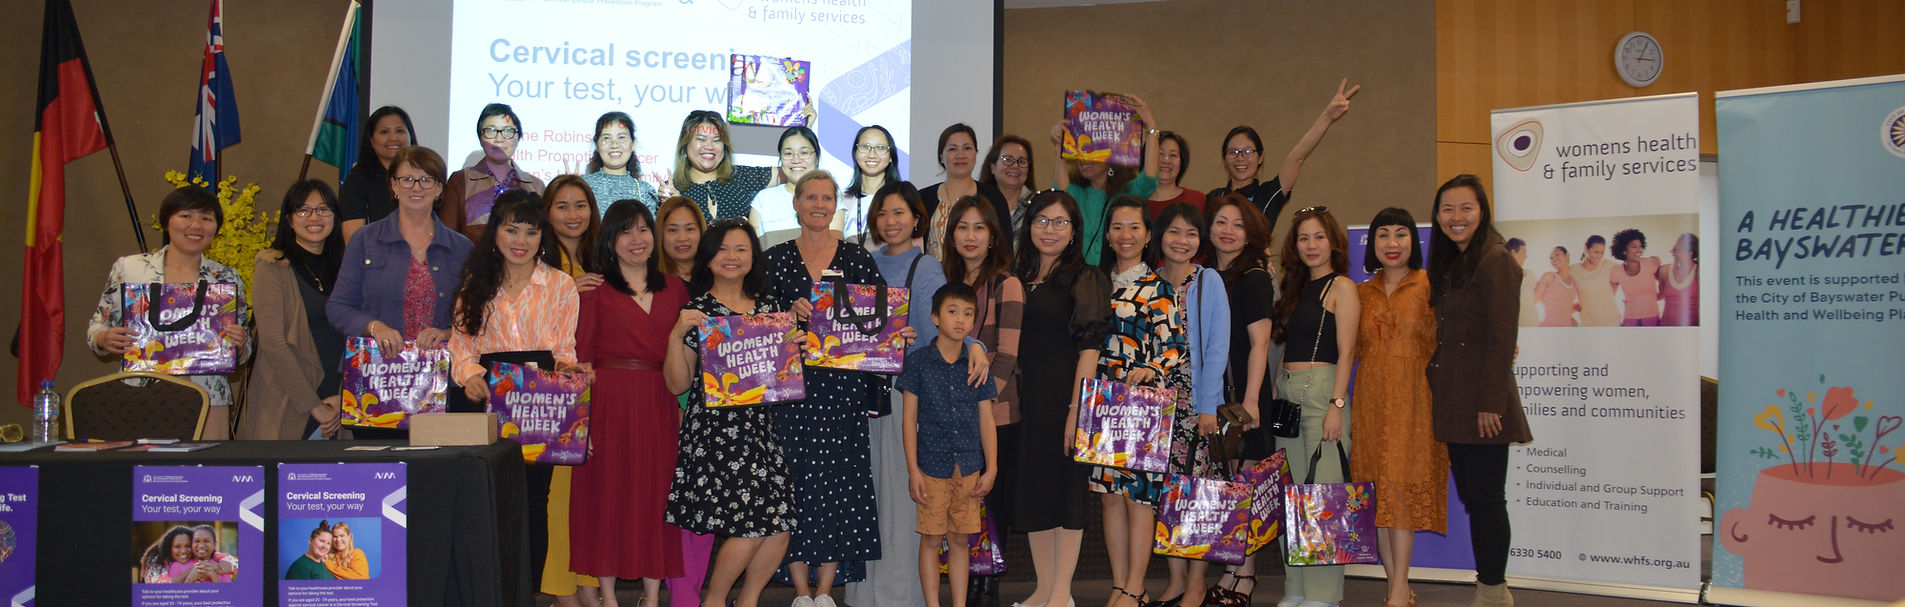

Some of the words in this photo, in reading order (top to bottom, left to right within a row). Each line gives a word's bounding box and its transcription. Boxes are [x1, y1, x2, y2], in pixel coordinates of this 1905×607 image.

[748, 6, 756, 19] &
[763, 6, 806, 24] family
[810, 10, 866, 24] services
[490, 38, 614, 66] Cervical
[625, 48, 731, 70] screen
[488, 72, 555, 98] Your
[563, 77, 622, 104] test,
[634, 84, 696, 108] your
[1079, 111, 1131, 122] WOMEN'S
[1084, 121, 1124, 131] HEALTH
[544, 129, 592, 143] Robins
[1092, 131, 1121, 142] WEEK
[1556, 141, 1630, 158] womens
[1638, 132, 1697, 152] health
[538, 149, 592, 162] Promoti
[1544, 164, 1555, 180] &
[1562, 160, 1616, 182] family
[1622, 156, 1697, 176] services
[1737, 210, 1754, 232] A
[1768, 202, 1905, 231] HEALTHIE
[1736, 276, 1762, 286] This
[1766, 276, 1805, 286] event
[1810, 274, 1820, 285] is
[1824, 273, 1900, 287] supported
[1736, 293, 1758, 304] the
[1761, 292, 1788, 305] City
[1792, 292, 1806, 303] of
[1810, 292, 1884, 304] Bayswater
[1736, 310, 1779, 321] Health
[1784, 310, 1808, 320] and
[1812, 309, 1884, 322] Wellbeing
[165, 332, 206, 348] WEEK
[717, 332, 784, 358] WOMEN'S
[726, 346, 779, 368] HEALTH
[362, 360, 433, 378] WOMEN'S
[738, 360, 776, 380] WEEK
[1512, 363, 1578, 380] upporting
[1583, 364, 1609, 377] and
[369, 374, 424, 389] HEALTH
[380, 388, 418, 402] WEEK
[505, 390, 578, 406] WOMEN'S
[1518, 384, 1588, 400] powering
[1592, 386, 1650, 400] women,
[512, 404, 567, 418] HEALTH
[1096, 404, 1160, 418] WOMEN'S
[1562, 404, 1586, 417] and
[1591, 405, 1686, 420] communities
[521, 419, 560, 433] WEEK
[1101, 417, 1151, 429] HEALTH
[1110, 430, 1146, 442] WEEK
[1526, 448, 1568, 458] Medical
[1526, 464, 1586, 477] Counselling
[1252, 470, 1280, 500] OMEN'S
[1526, 481, 1577, 491] Individual
[1580, 483, 1600, 493] and
[1603, 485, 1638, 496] Group
[1640, 486, 1684, 497] Support
[8, 493, 27, 502] Test
[142, 494, 177, 503] Cervical
[180, 494, 223, 504] Screening
[286, 492, 321, 500] Cervical
[323, 492, 366, 501] Screening
[1250, 484, 1280, 516] HEALTH
[142, 505, 160, 513] Your
[163, 505, 182, 514] test,
[183, 506, 202, 515] your
[204, 506, 221, 515] way
[286, 502, 305, 511] Your
[308, 502, 326, 512] test,
[327, 504, 345, 512] your
[347, 504, 364, 512] way
[1175, 499, 1238, 511] WOMEN'S
[1260, 498, 1280, 522] WEEK
[1526, 497, 1578, 508] Education
[1580, 500, 1600, 510] and
[1604, 501, 1648, 514] Training
[1180, 511, 1231, 522] HEALTH
[1510, 548, 1534, 558] 6330
[1537, 549, 1562, 560] 5400
[1590, 554, 1690, 570] www.whfs.org.au
